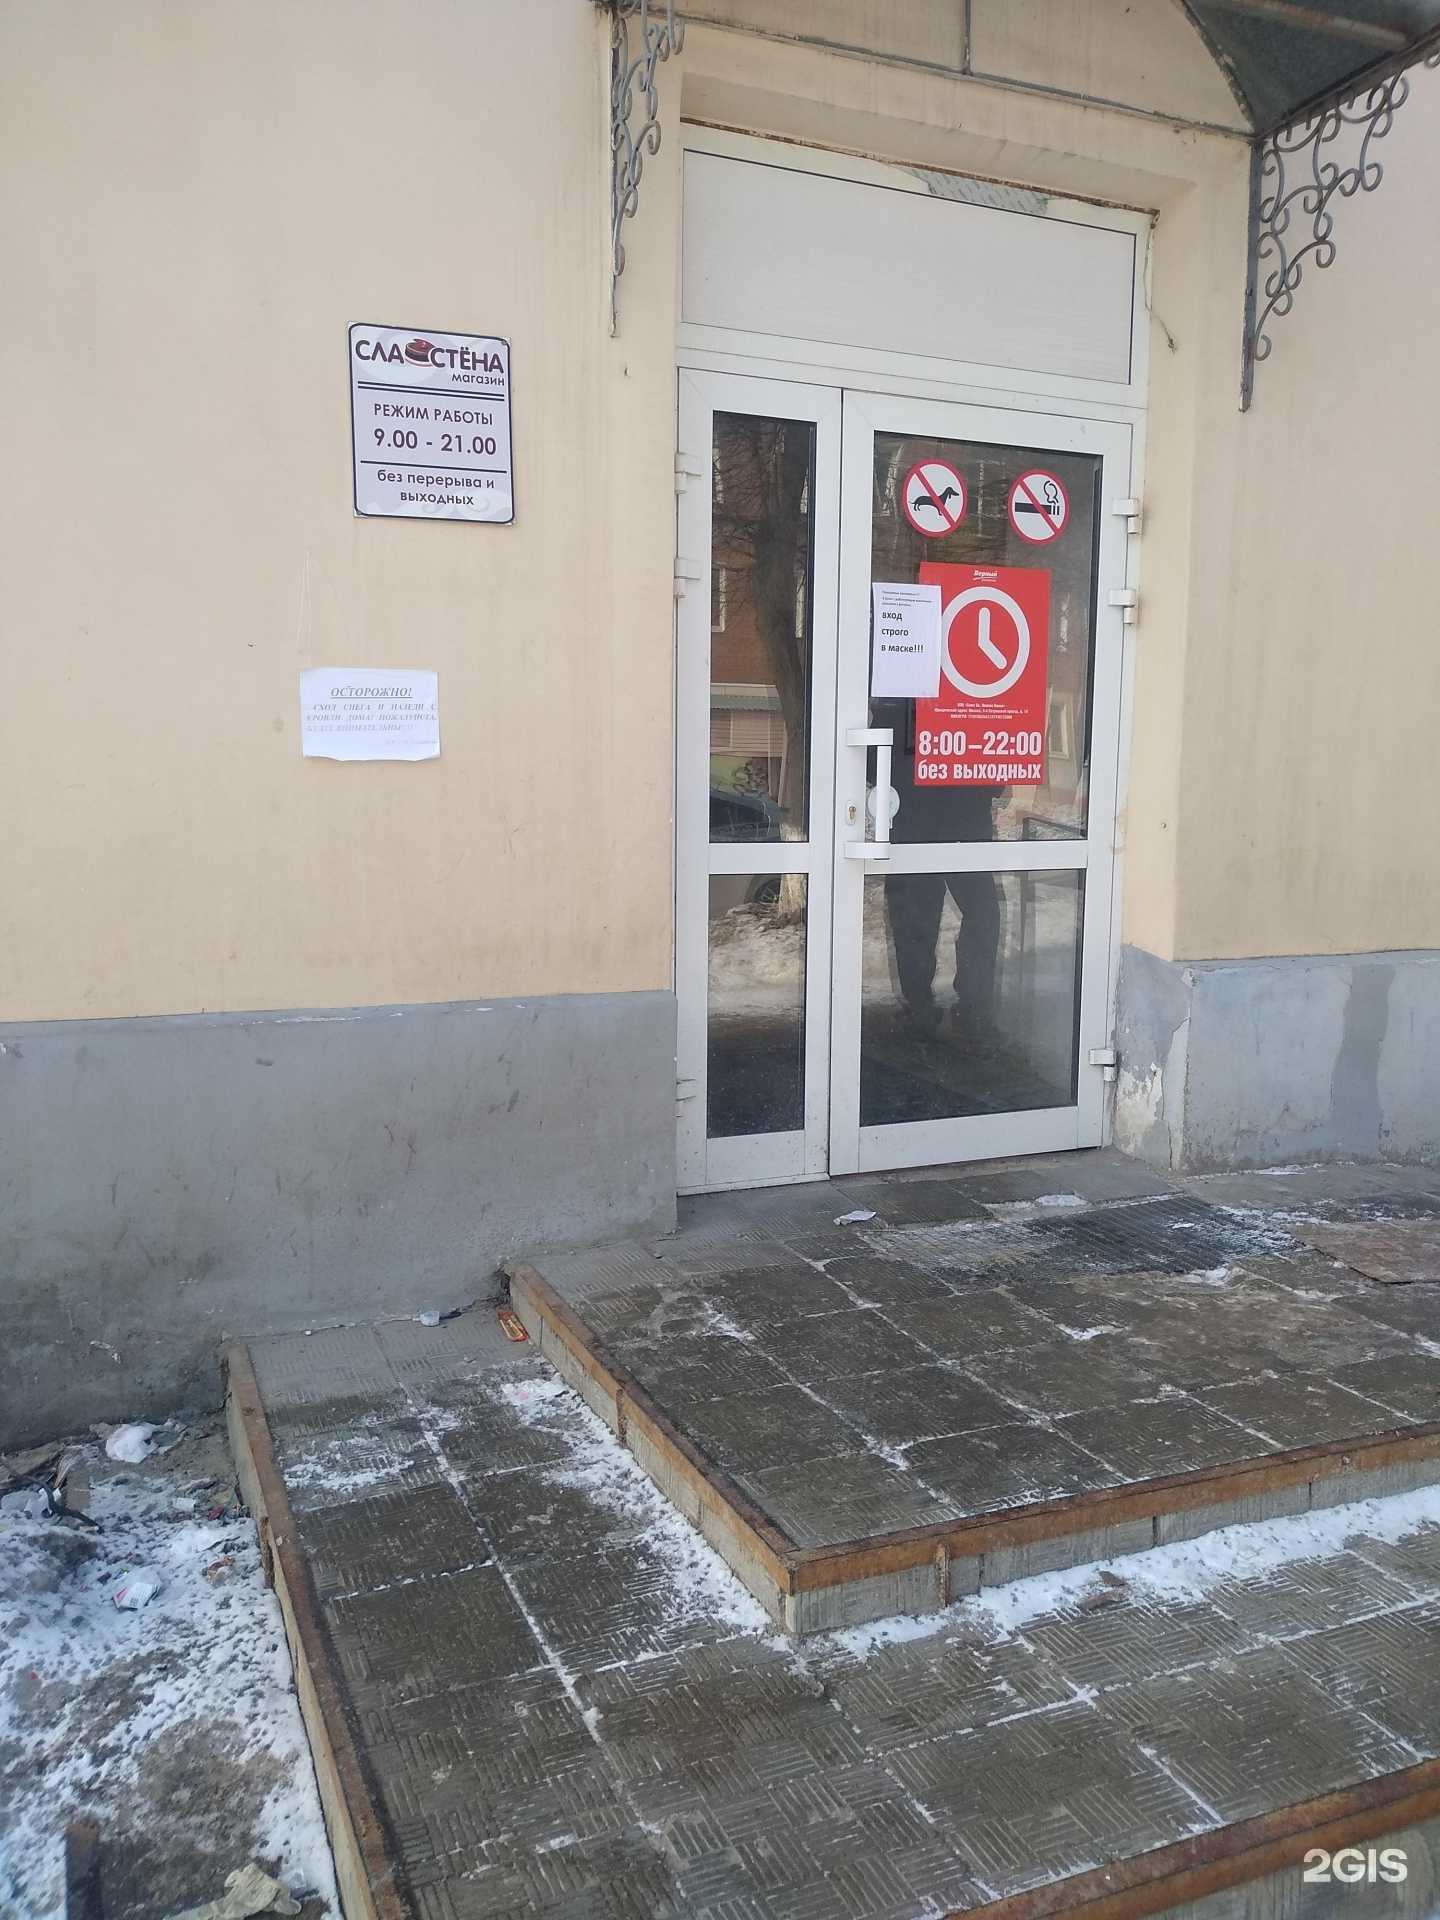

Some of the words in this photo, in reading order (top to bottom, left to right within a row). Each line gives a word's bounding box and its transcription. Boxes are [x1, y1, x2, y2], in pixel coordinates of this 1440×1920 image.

[451, 373, 505, 386] магазин
[374, 403, 430, 420] РЕЖИМ
[434, 408, 493, 426] РАБОТЫ
[374, 428, 418, 449] 9.00
[440, 433, 497, 455] 21.00
[377, 469, 403, 483] без
[407, 473, 482, 489] перерыва
[486, 479, 494, 489] и
[400, 491, 474, 506] выходных
[882, 611, 903, 621] вход
[881, 628, 909, 637] строго
[888, 645, 924, 653] маске!!!
[330, 687, 413, 699] ОСТОРОЖНО!
[918, 760, 947, 779] без
[953, 763, 1042, 781] выходных
